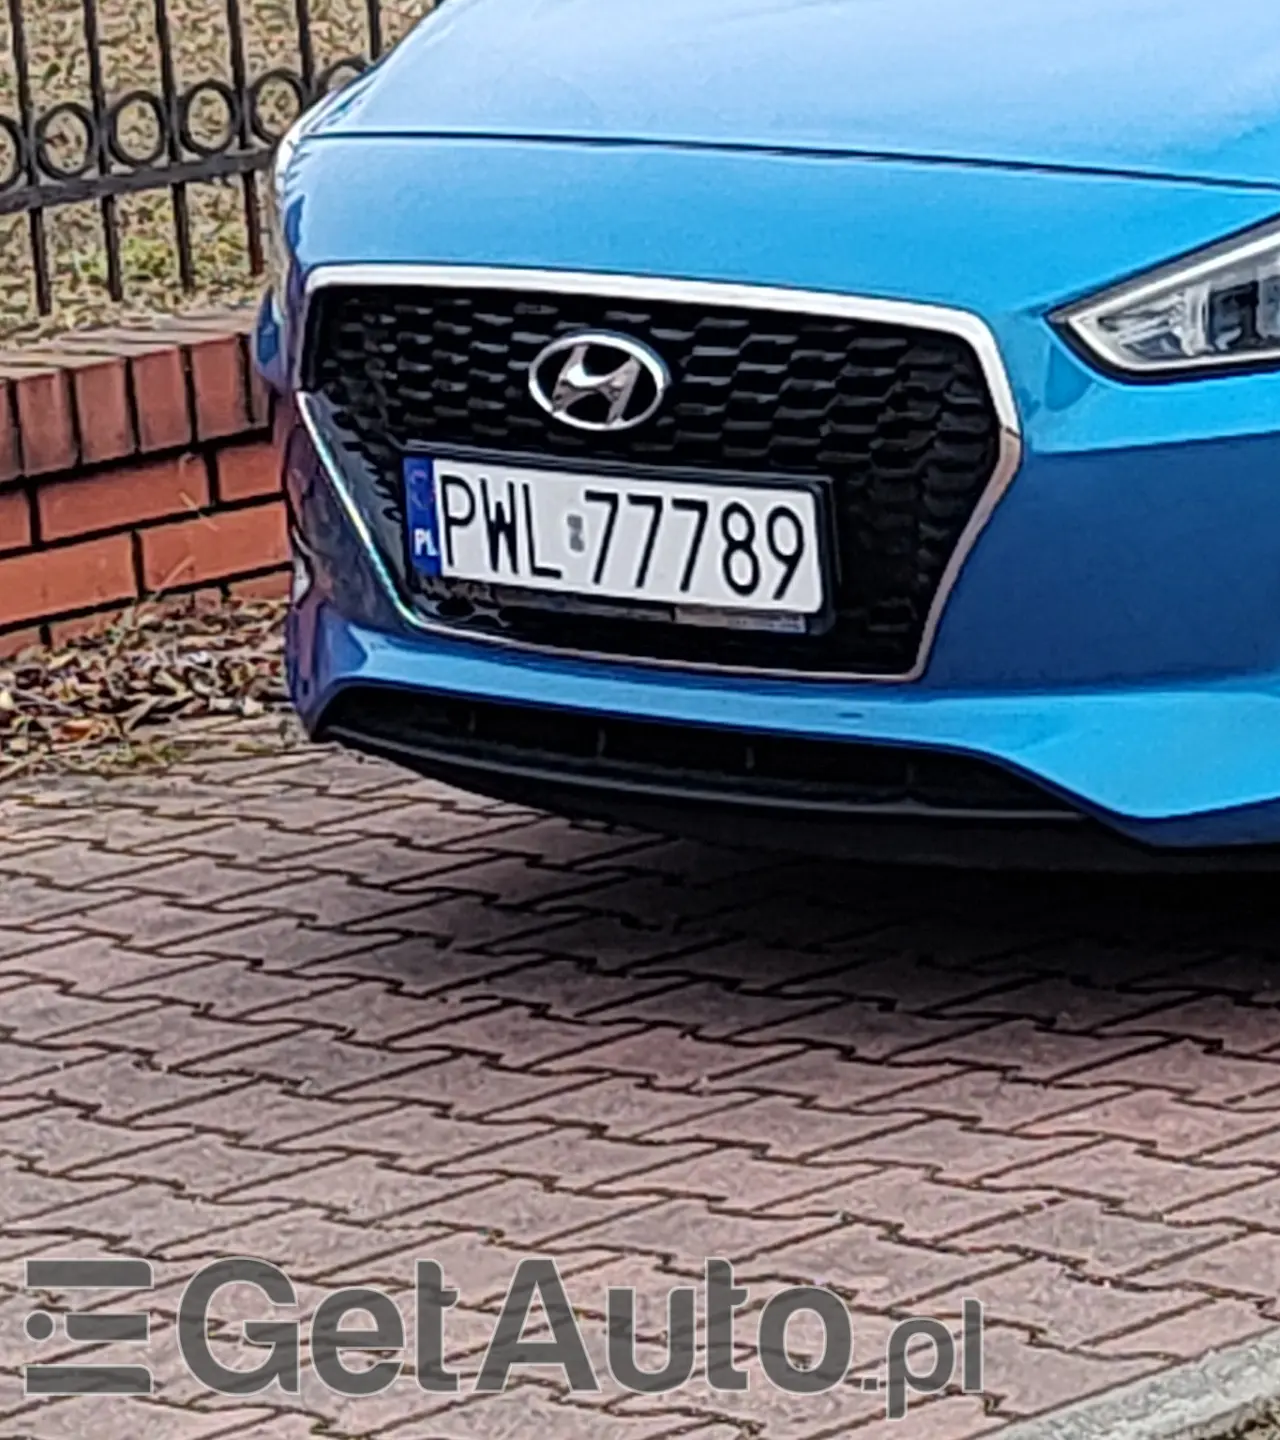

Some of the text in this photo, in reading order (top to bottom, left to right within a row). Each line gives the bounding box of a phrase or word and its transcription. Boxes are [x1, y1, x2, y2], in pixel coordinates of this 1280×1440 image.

[414, 528, 438, 556] PL
[440, 475, 804, 600] PWL 77789
